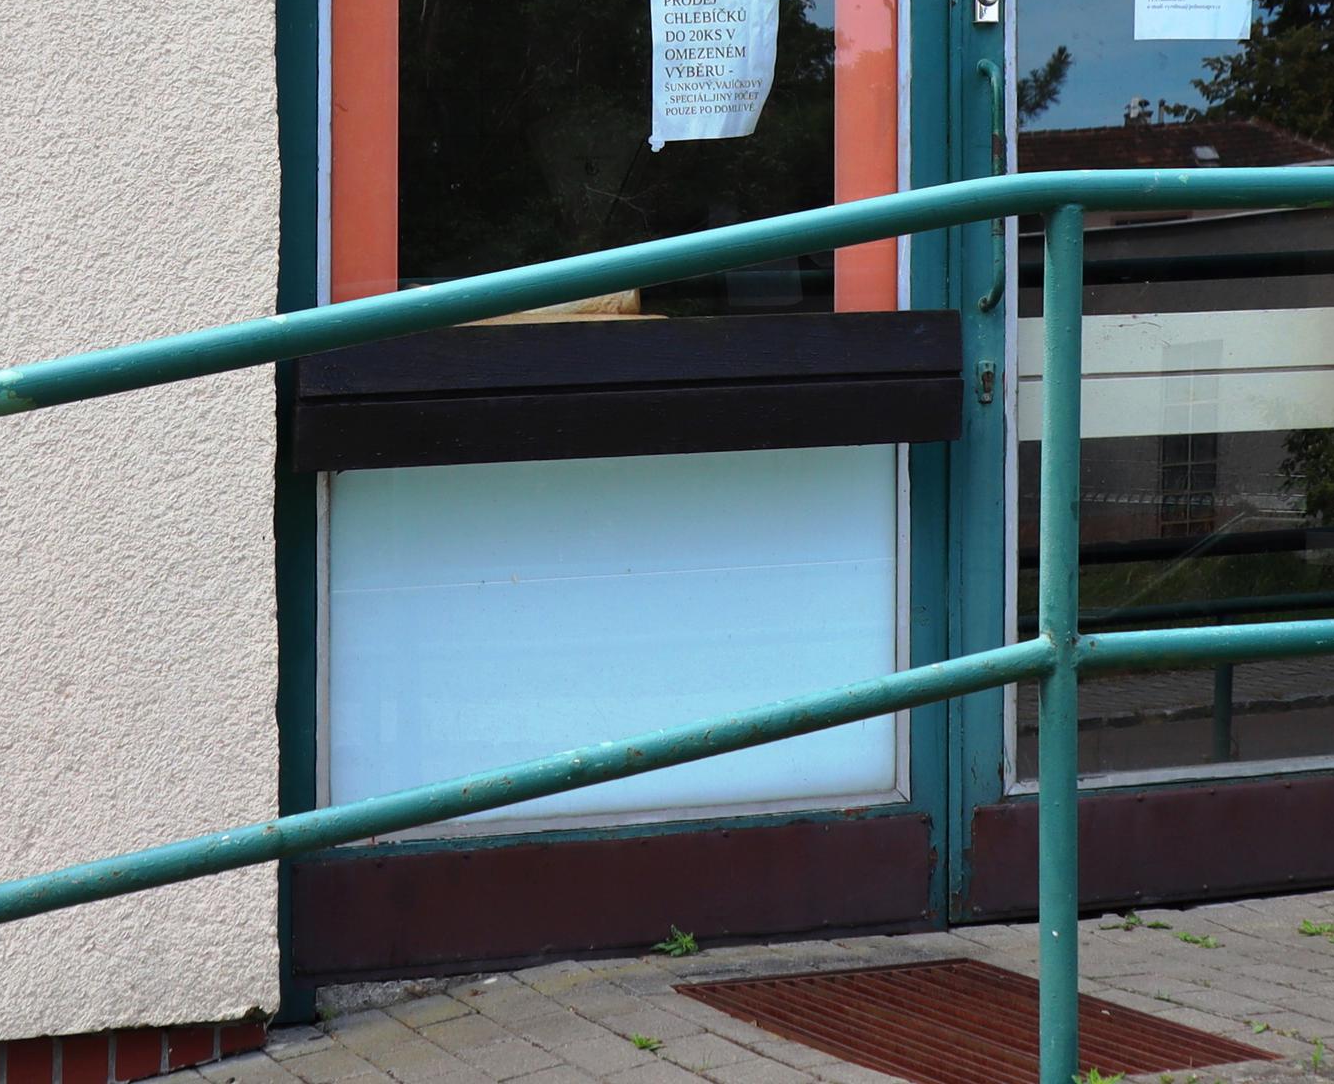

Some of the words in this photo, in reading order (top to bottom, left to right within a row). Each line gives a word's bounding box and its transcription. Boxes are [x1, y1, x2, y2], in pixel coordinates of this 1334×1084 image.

[664, 7, 747, 24] CHLEBÍČKŮ
[665, 30, 685, 42] DO
[689, 29, 722, 41] 20KS
[725, 28, 736, 40] V
[665, 44, 746, 60] OMEZENÉM
[665, 62, 725, 78] VÝBĚRU
[665, 106, 697, 116] POUZE
[699, 105, 712, 114] PO
